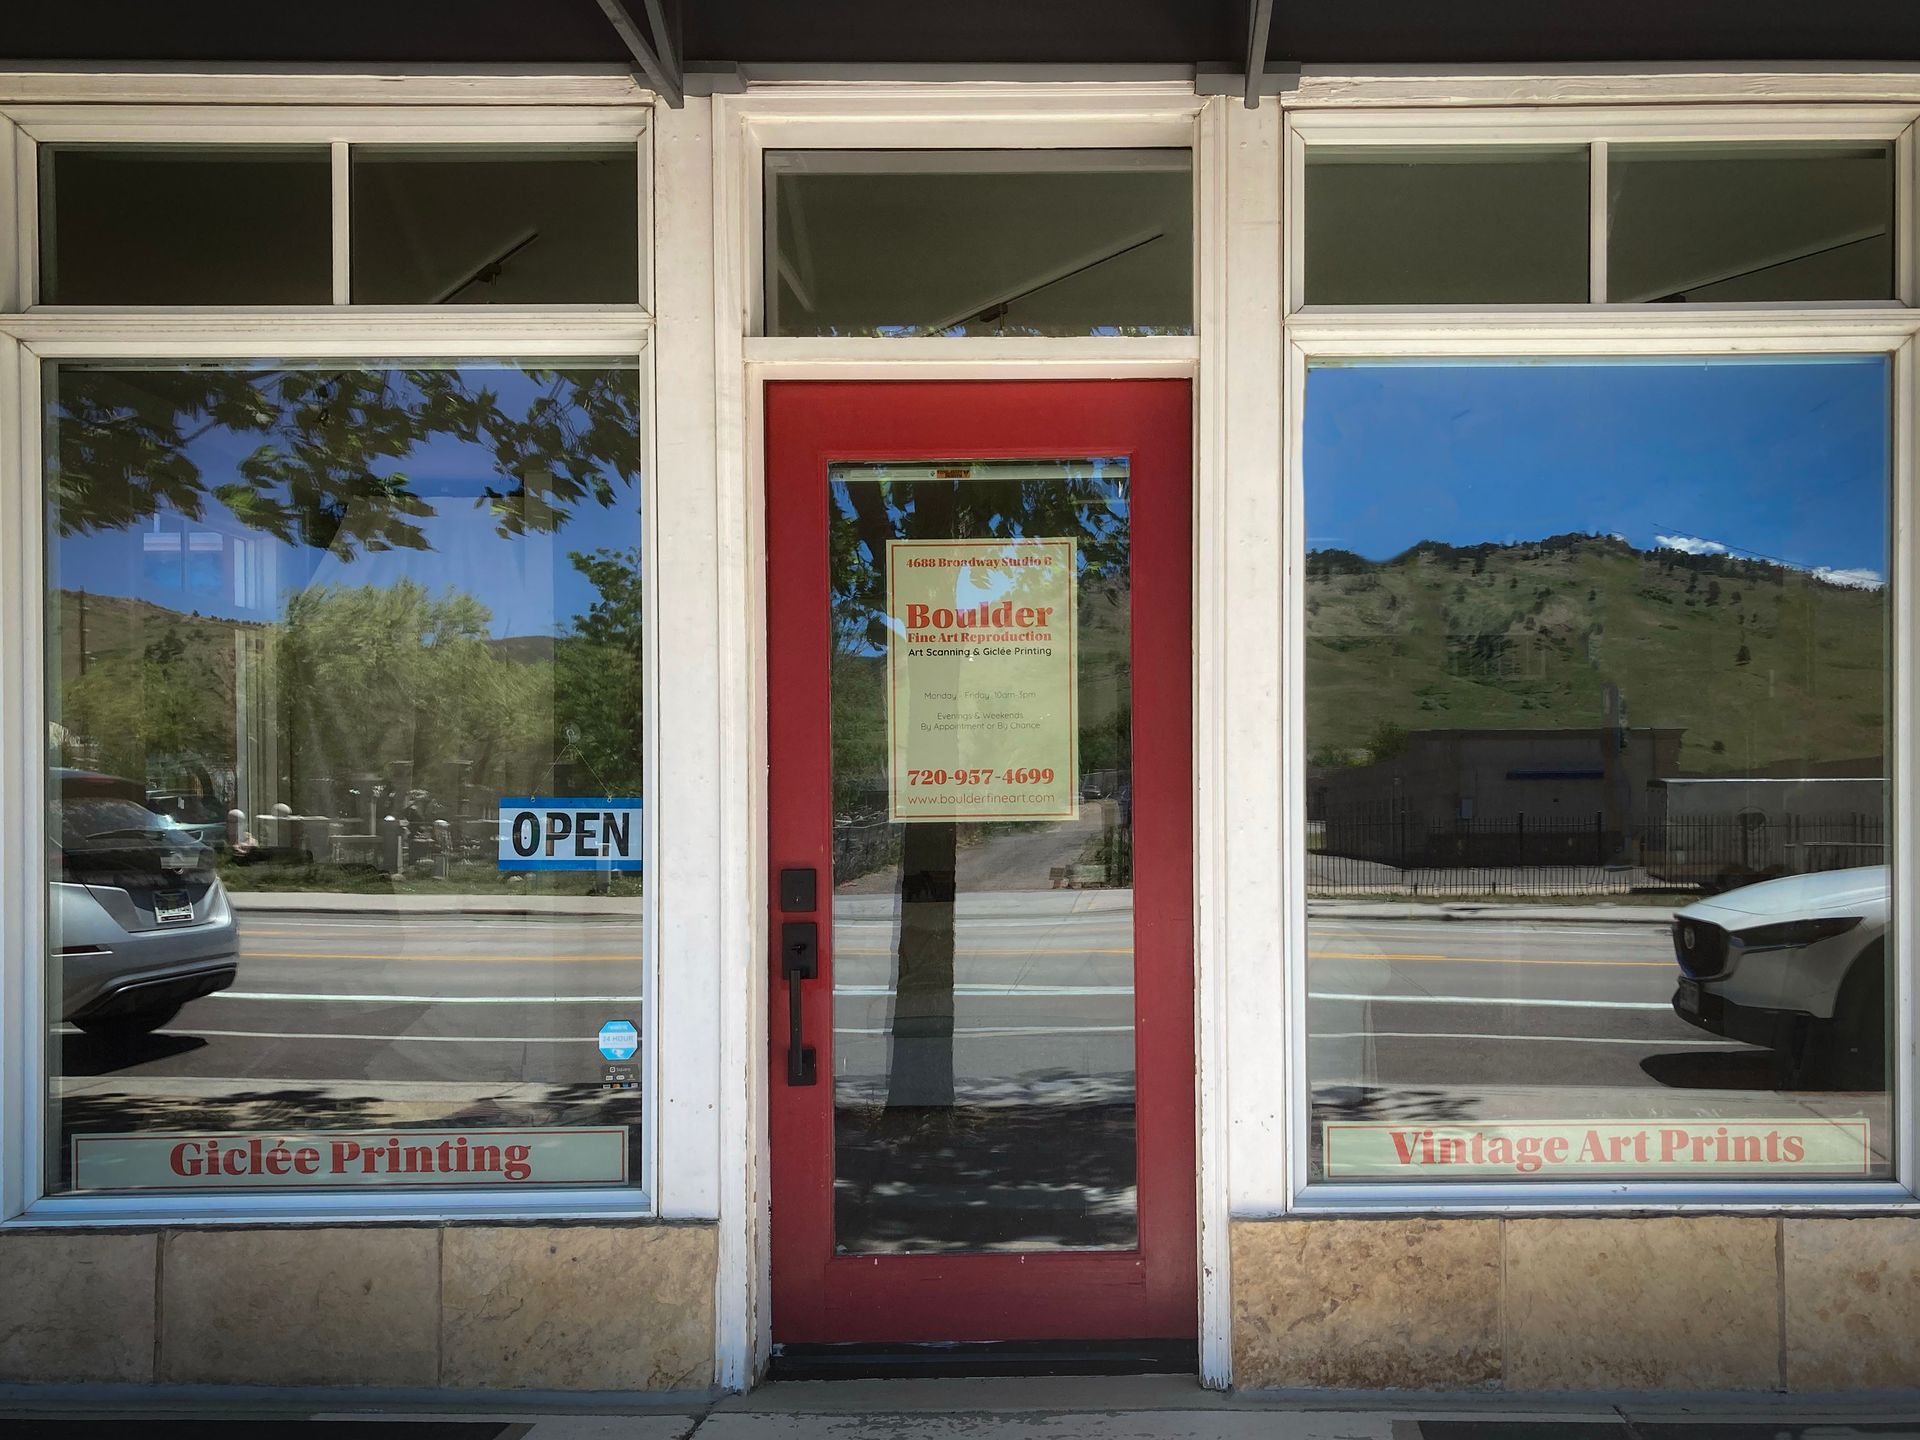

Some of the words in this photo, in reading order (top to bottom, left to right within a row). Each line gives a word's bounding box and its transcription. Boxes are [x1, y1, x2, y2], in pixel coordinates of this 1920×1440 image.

[906, 557, 936, 568] 4688
[938, 557, 1000, 569] Broadway
[1002, 556, 1041, 567] Studio
[906, 601, 1053, 629] Boulder
[907, 633, 936, 643] Fine
[938, 632, 958, 643] Art
[961, 631, 1052, 644] Reproduction
[908, 648, 924, 657] Art
[926, 648, 970, 658] Scanning
[973, 648, 980, 656] &
[983, 647, 1012, 656] Giclée
[1014, 646, 1052, 657] Printing
[924, 692, 957, 701] Monday
[937, 713, 973, 721] Evenings
[983, 711, 1024, 720] Weekends
[920, 723, 931, 731] By
[933, 722, 985, 731] Appointment
[997, 722, 1007, 730] By
[1010, 721, 1041, 729] Chance
[907, 768, 1055, 786] 720-957-4699
[907, 793, 1055, 805] www.boulderfineart.com
[512, 811, 630, 856] OPEN
[1389, 1129, 1568, 1173] Vintage
[1576, 1129, 1651, 1164] Art
[1658, 1127, 1805, 1164] Prints
[169, 1138, 320, 1177] Giclée
[329, 1137, 532, 1180] Printing
